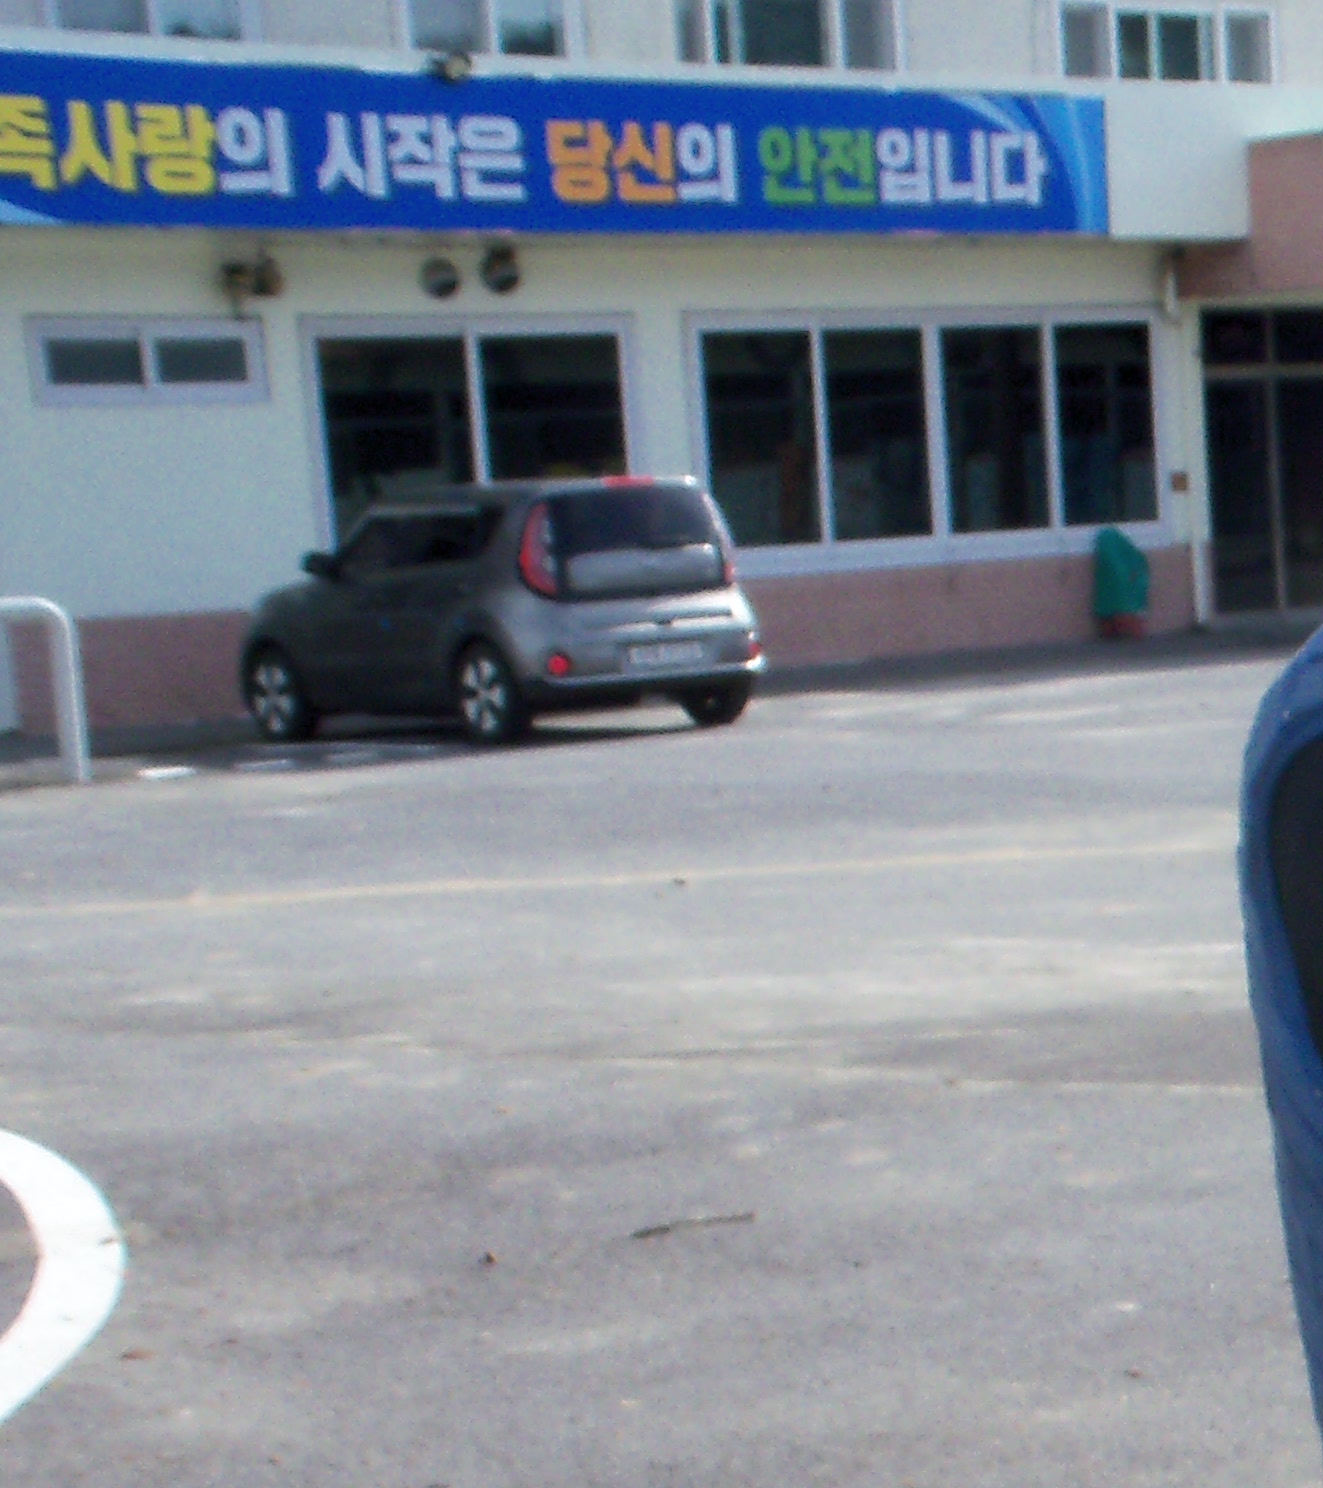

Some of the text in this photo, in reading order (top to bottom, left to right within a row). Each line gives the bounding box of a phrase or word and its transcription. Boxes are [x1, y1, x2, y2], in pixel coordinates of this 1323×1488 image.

[316, 110, 527, 201] 시작은
[545, 118, 738, 205] 당신의
[758, 125, 1049, 207] 안전입니다
